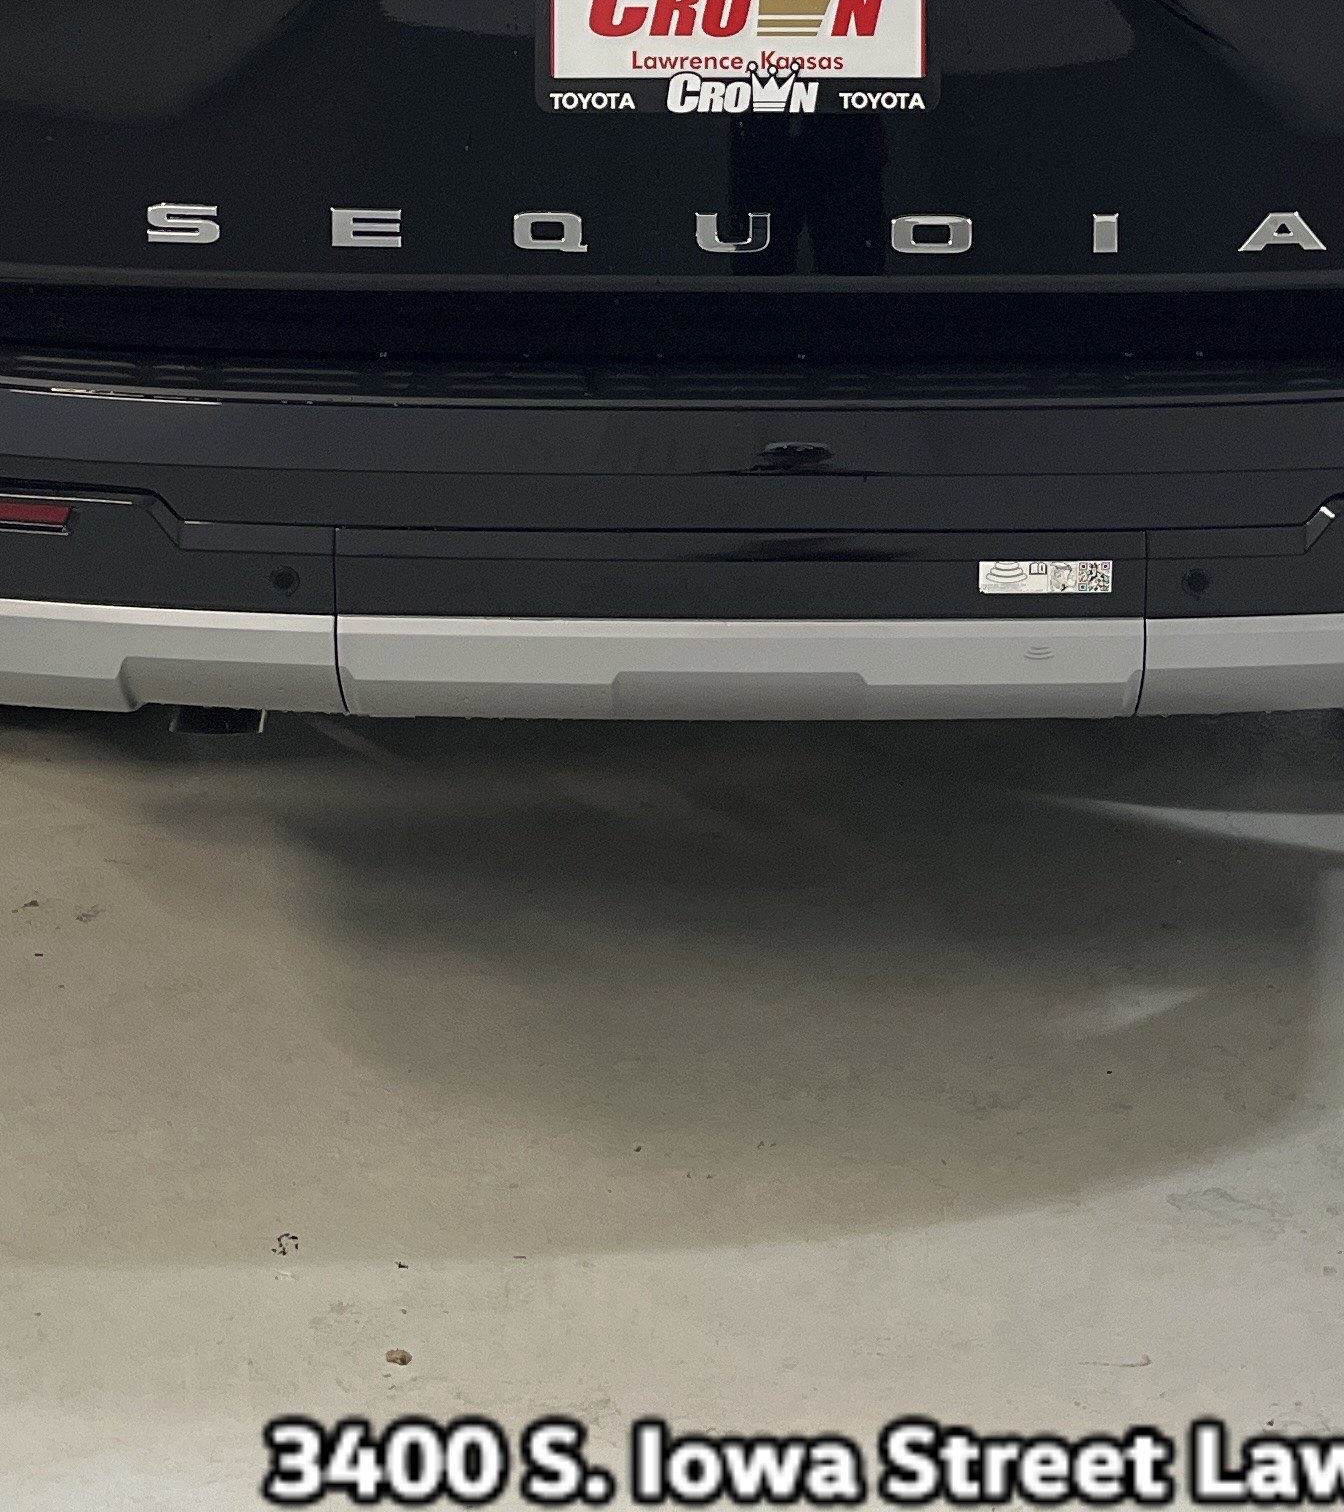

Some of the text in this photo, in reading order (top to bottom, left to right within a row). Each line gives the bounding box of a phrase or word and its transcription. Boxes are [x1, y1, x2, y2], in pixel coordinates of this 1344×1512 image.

[631, 50, 844, 72] Lawrence, Kansas
[550, 91, 636, 111] TOYOTA
[838, 91, 926, 111] TOYOTA
[144, 201, 1329, 254] SEQUOIA
